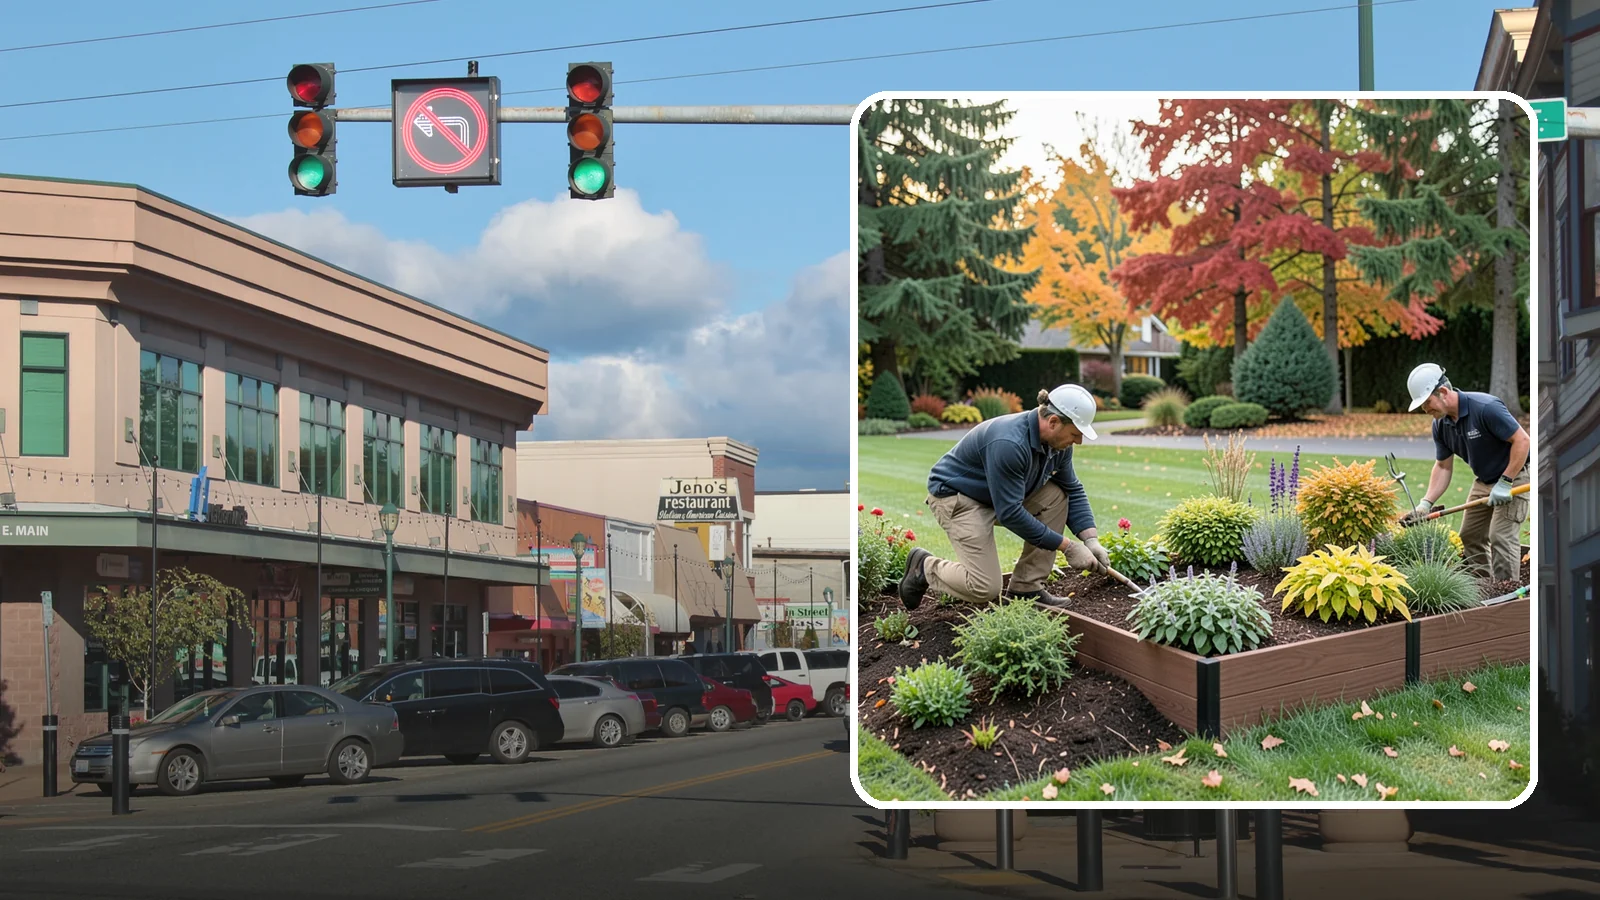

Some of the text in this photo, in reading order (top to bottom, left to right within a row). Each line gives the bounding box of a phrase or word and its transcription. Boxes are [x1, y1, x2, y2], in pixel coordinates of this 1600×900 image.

[670, 479, 728, 494] Jeno's
[664, 496, 731, 509] restaurant
[658, 509, 682, 520] Italian
[686, 509, 715, 520] American
[715, 509, 738, 520] Cuisine
[2, 525, 49, 536] E. MAIN
[797, 607, 828, 616] Street
